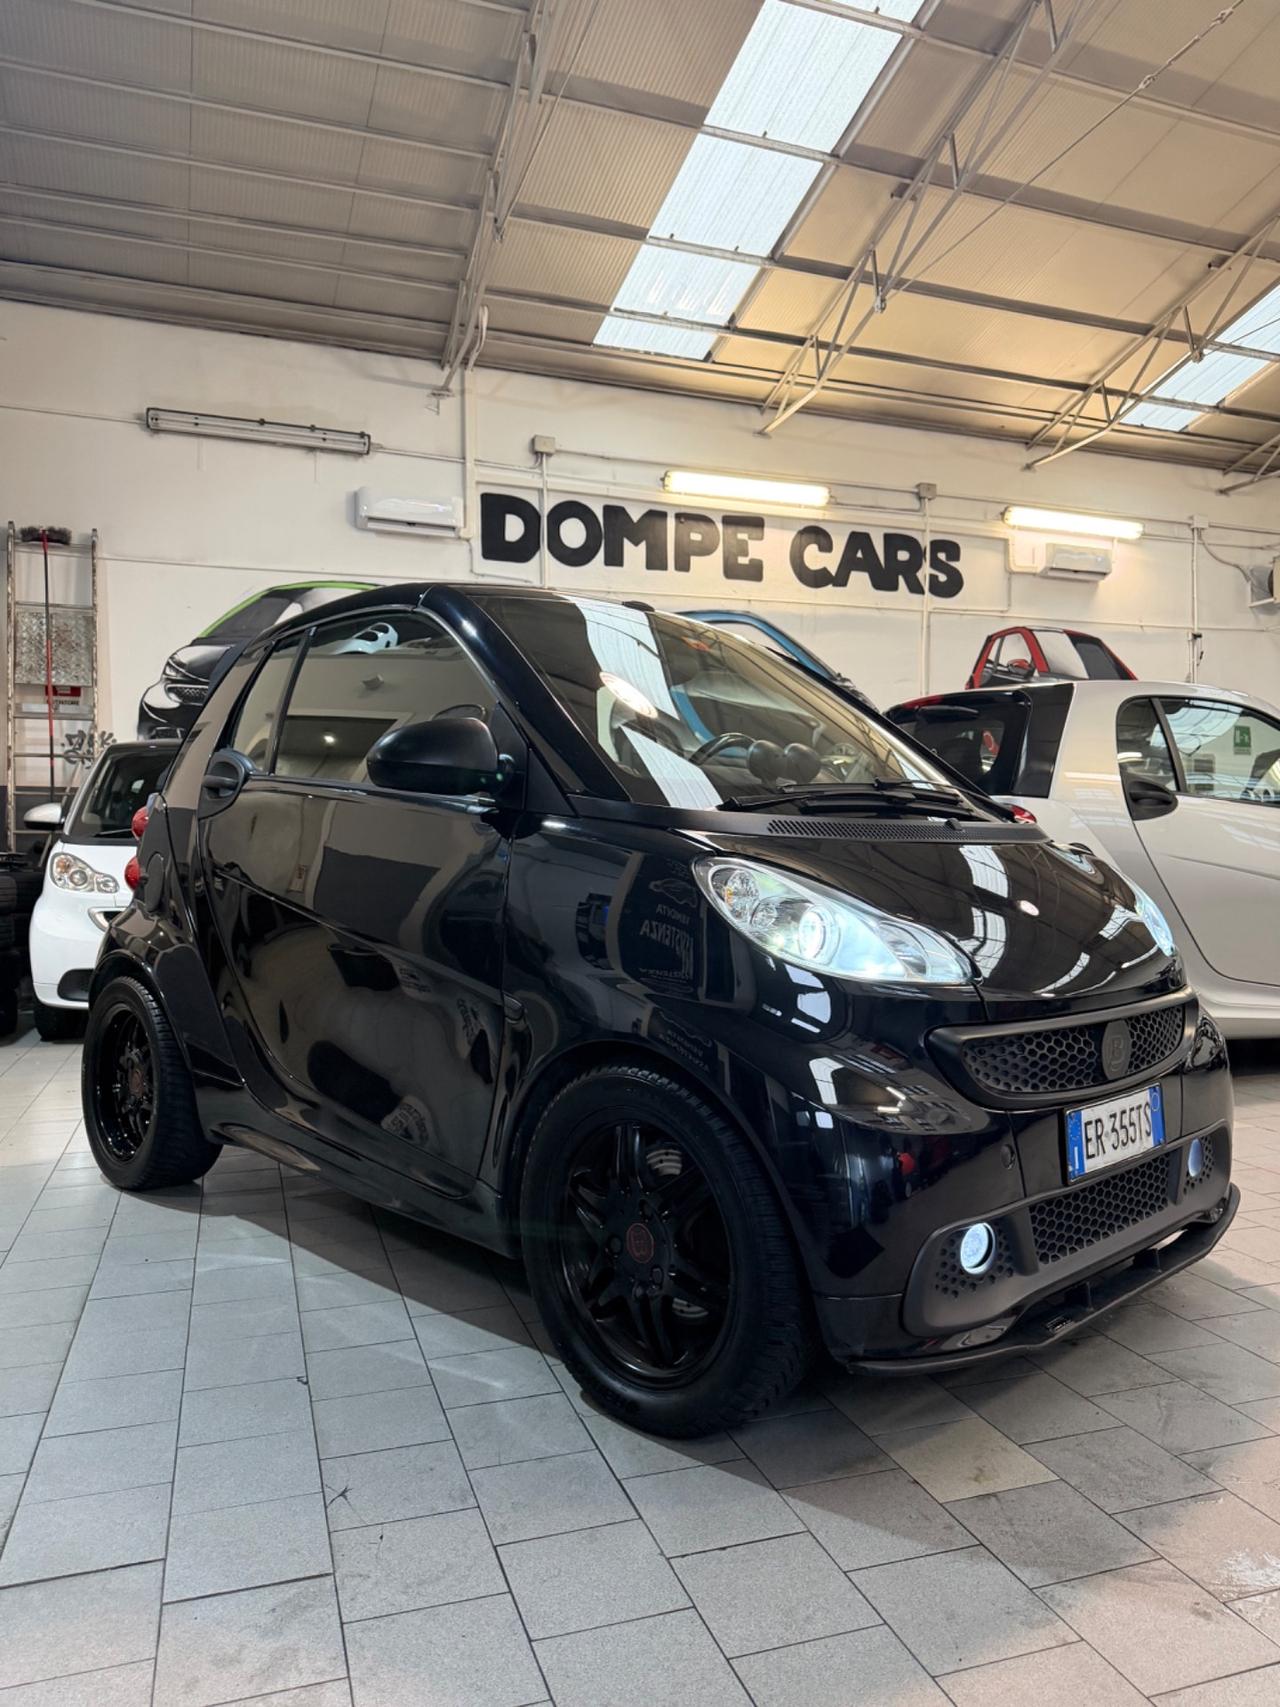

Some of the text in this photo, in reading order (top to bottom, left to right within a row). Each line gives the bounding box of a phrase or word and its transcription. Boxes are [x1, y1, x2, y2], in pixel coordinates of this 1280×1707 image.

[480, 493, 965, 599] DOMPE CARS
[1084, 1118, 1106, 1159] ER
[1109, 1101, 1152, 1150] 355TS
